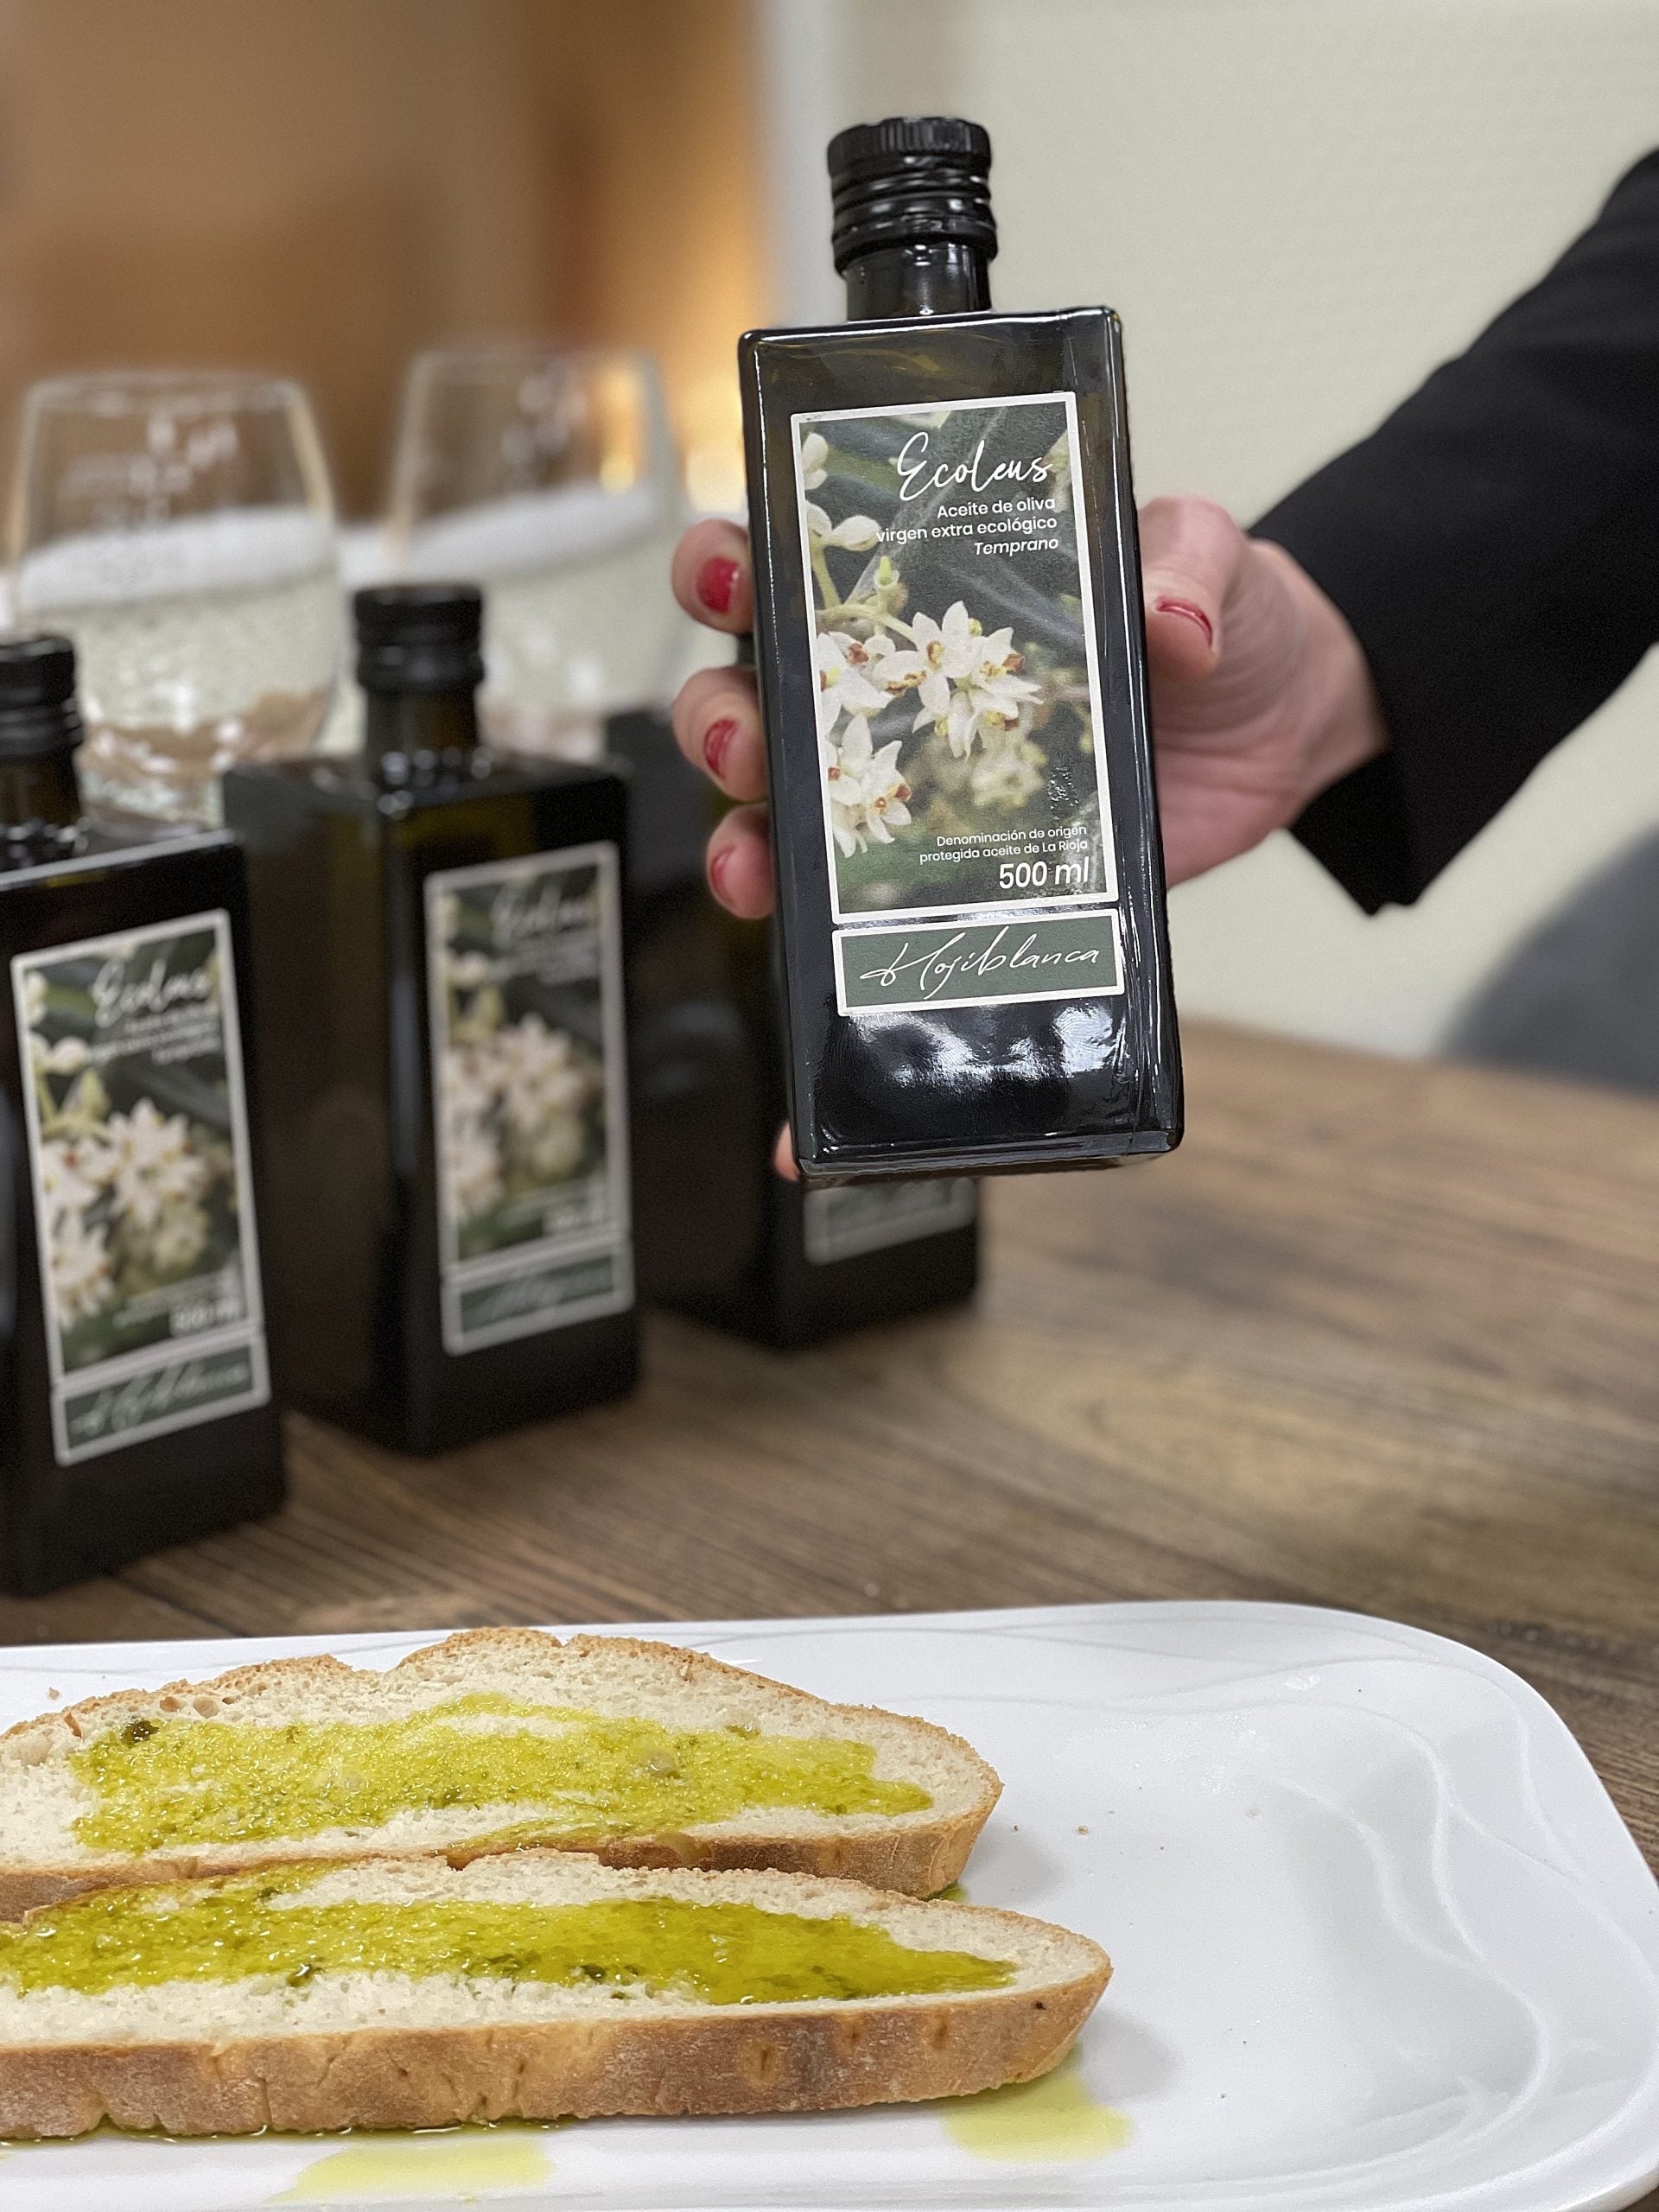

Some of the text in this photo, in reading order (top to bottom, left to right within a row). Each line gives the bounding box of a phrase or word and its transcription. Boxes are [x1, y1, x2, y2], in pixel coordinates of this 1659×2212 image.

[897, 431, 1053, 501] Ecoleus
[937, 496, 1056, 518] Aceite de oliva
[876, 516, 1058, 545] virgen extra ecológico
[974, 537, 1059, 557] Temprano
[936, 825, 1087, 847] Denominación de origen
[919, 838, 1088, 865] protegida aceite de La Rioja
[999, 856, 1090, 890] 500 ml
[860, 925, 1100, 1000] Hojiblanca
